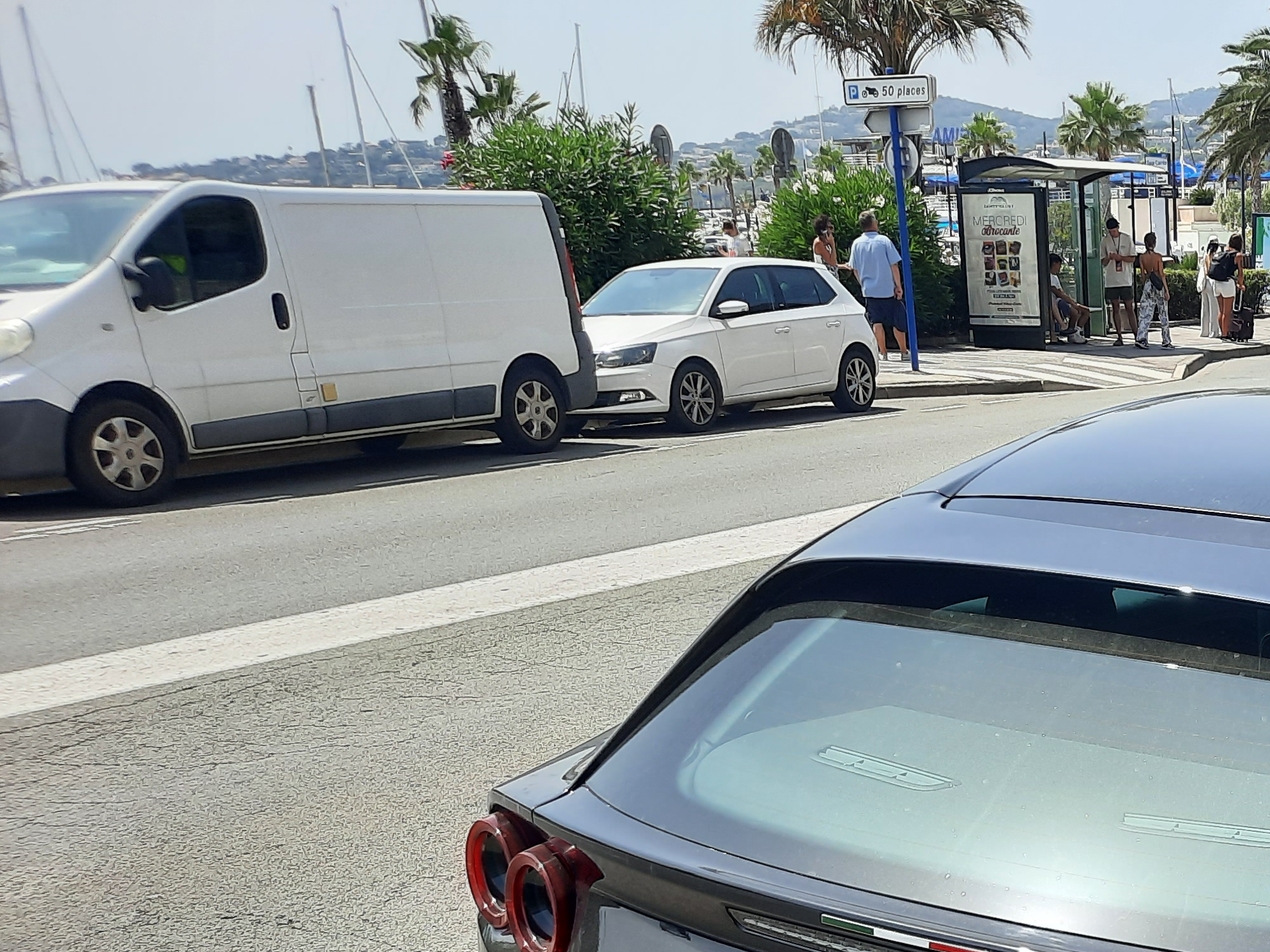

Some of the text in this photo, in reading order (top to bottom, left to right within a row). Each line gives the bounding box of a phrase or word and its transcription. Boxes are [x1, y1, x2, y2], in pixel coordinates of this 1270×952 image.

[881, 85, 894, 97] 50
[897, 85, 926, 99] places
[972, 215, 1027, 226] MERCREDI
